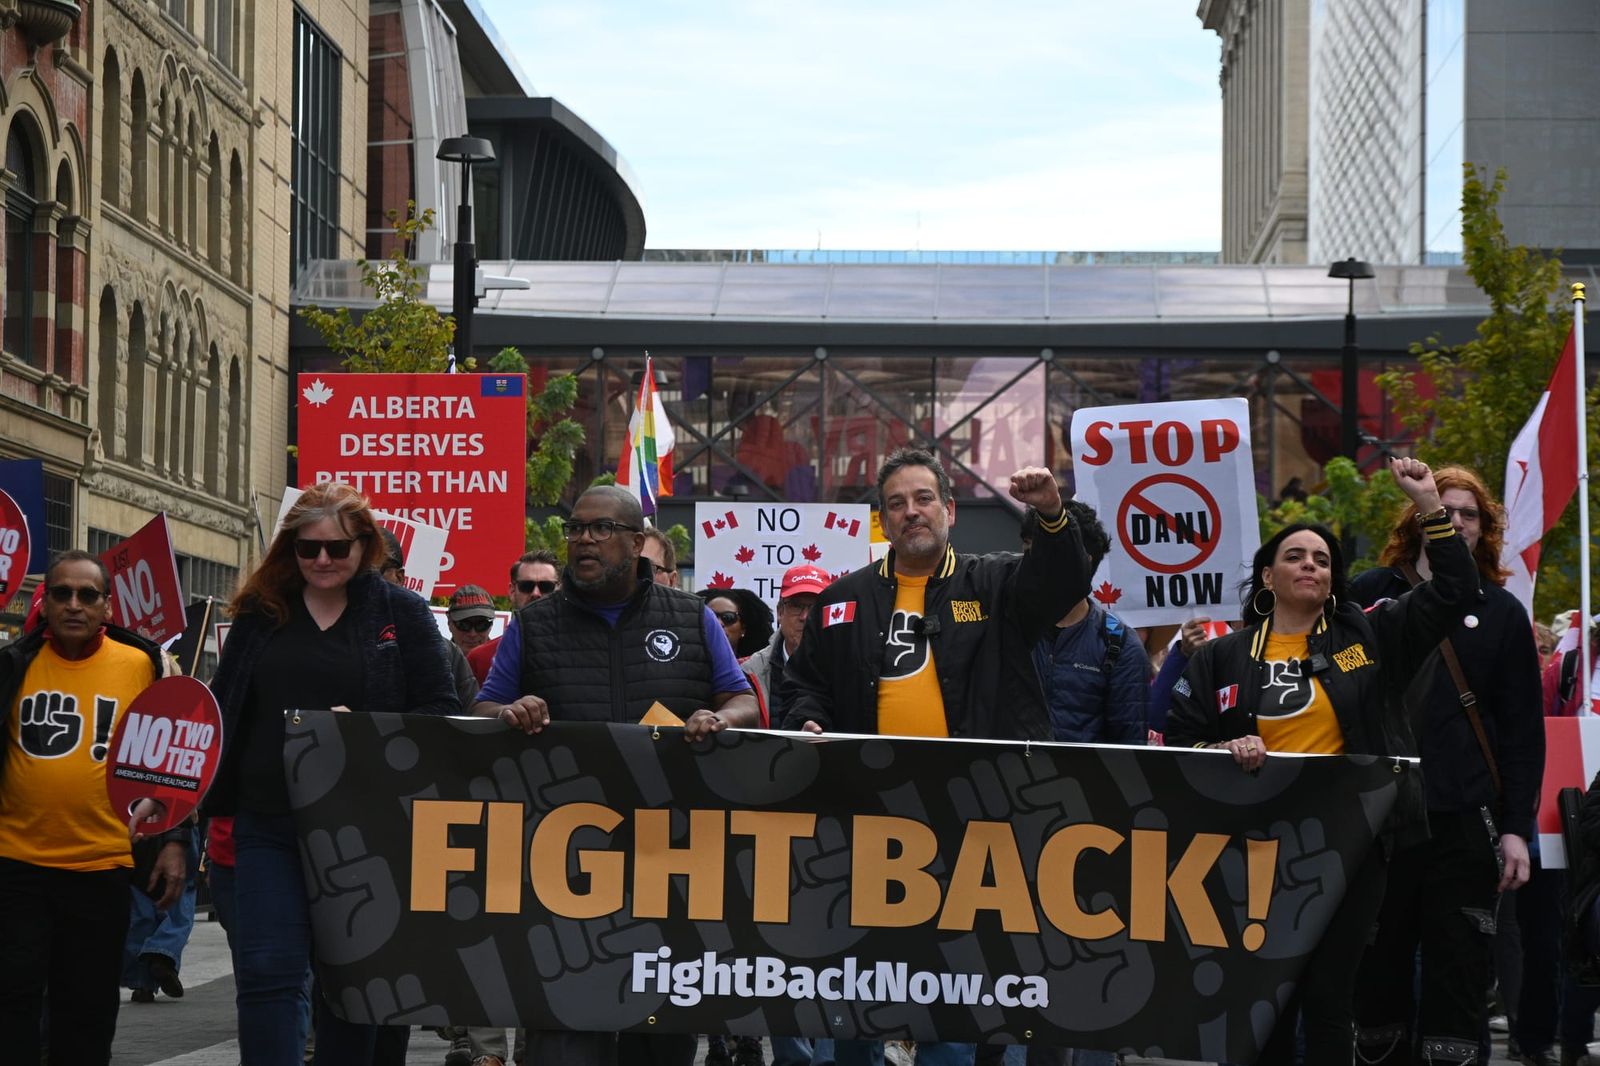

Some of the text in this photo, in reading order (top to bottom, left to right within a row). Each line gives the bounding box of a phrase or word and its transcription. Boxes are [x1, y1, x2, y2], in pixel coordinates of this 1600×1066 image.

[348, 396, 475, 419] ALBERTA
[340, 433, 484, 457] DESERVES
[1081, 419, 1240, 467] STOP
[315, 470, 508, 494] BETTER THAN
[757, 508, 801, 532] NO
[1131, 510, 1210, 546] DANI
[762, 545, 795, 565] TO
[114, 559, 161, 628] NO.
[791, 574, 823, 584] Canada
[1145, 572, 1223, 608] NOW
[951, 600, 973, 608] FIGHT
[116, 712, 173, 769] NO
[173, 719, 214, 751] TWO
[165, 746, 206, 778] TIER
[115, 769, 197, 789] AMERICAN-STYLE HEALTHCARE
[410, 799, 1280, 952] FIGHT BACK!
[631, 945, 1049, 1008] FightBackNow.ca
